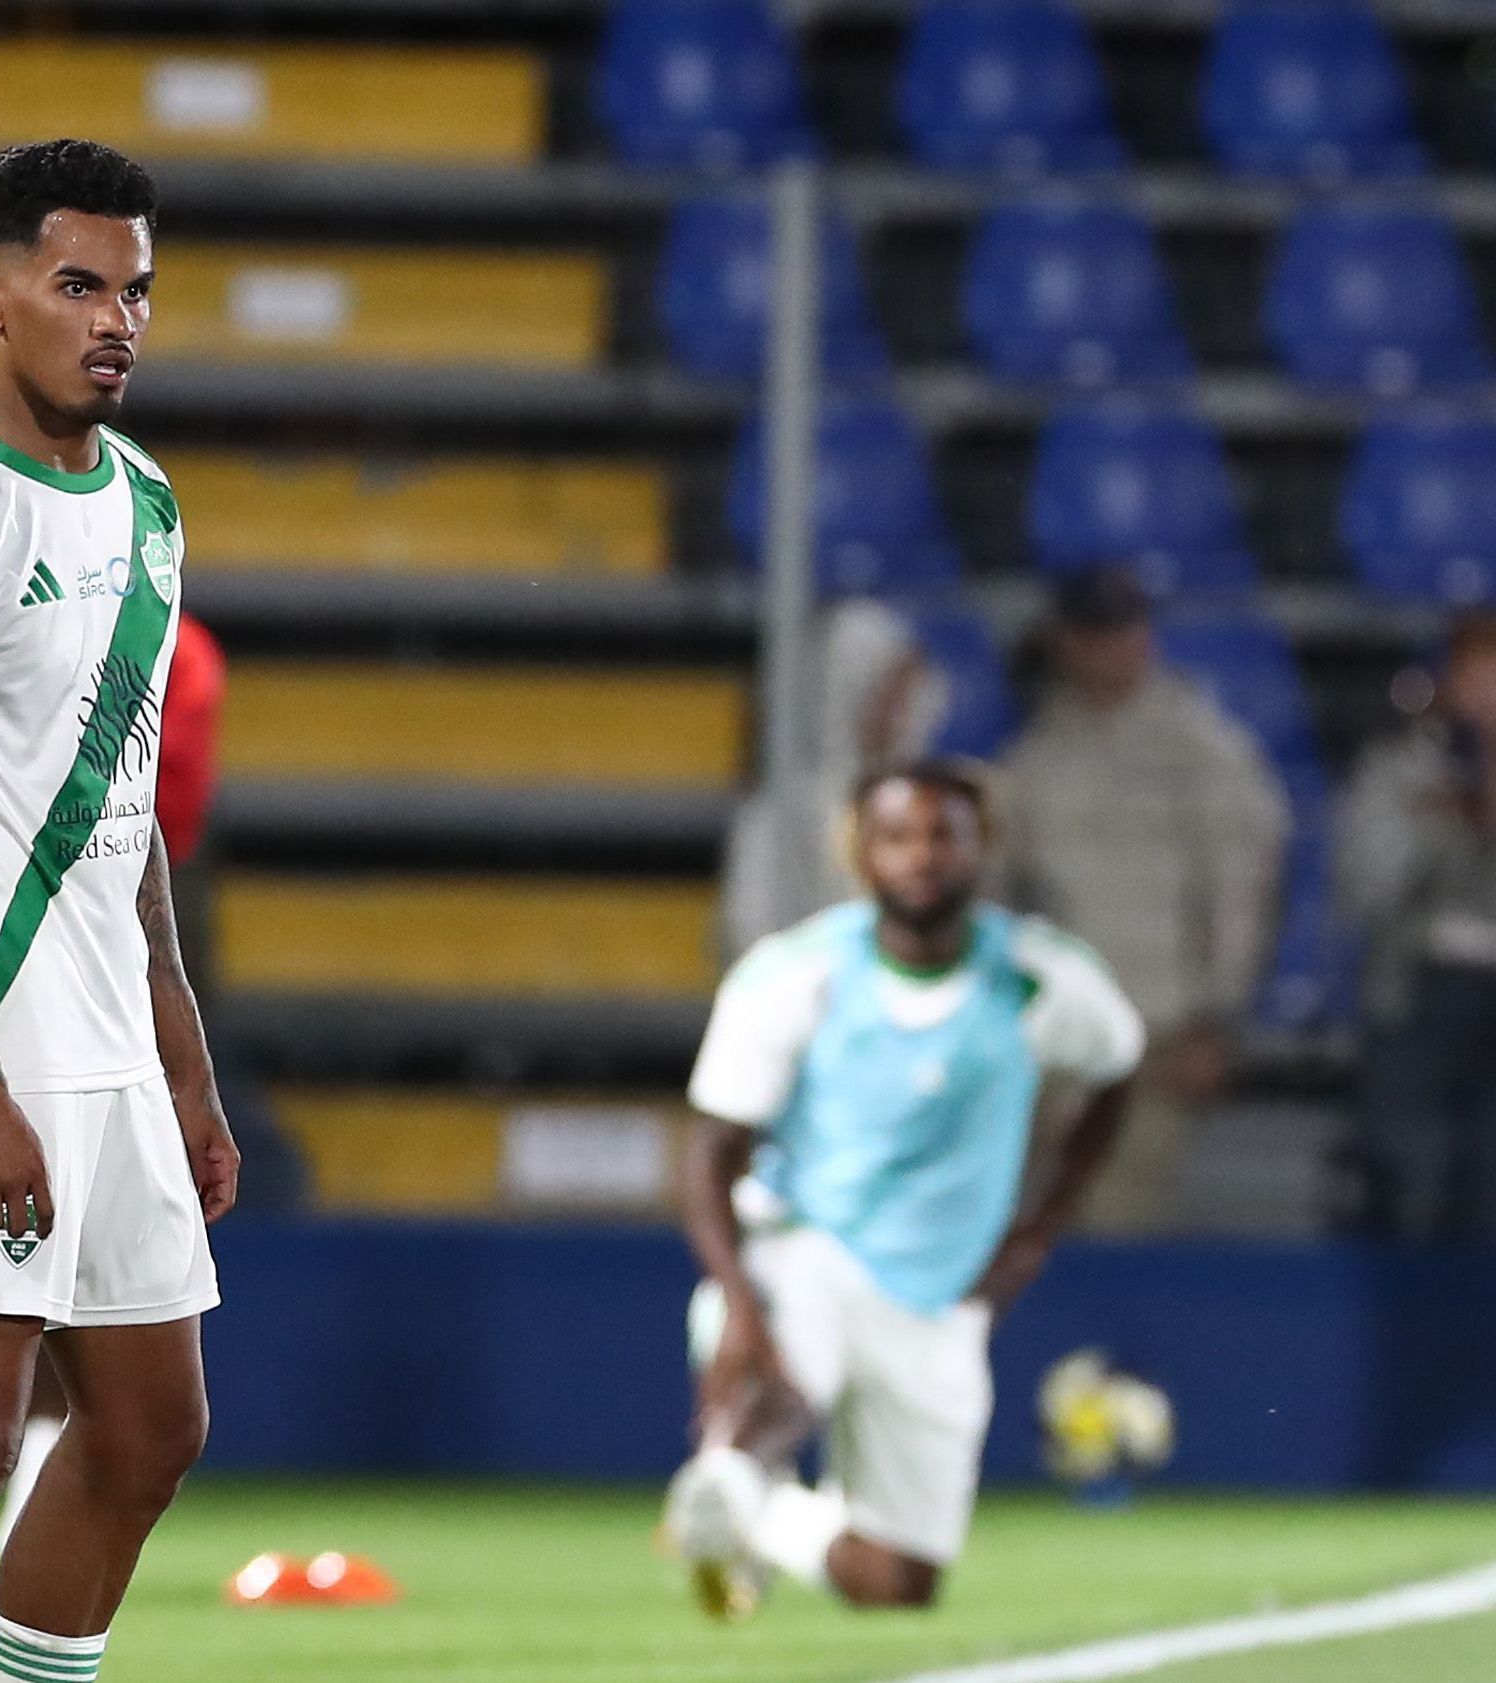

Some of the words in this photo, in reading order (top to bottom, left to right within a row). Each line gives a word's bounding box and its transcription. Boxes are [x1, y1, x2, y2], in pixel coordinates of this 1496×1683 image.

[79, 584, 106, 599] SIRC
[57, 834, 98, 860] Red
[103, 834, 129, 857] Sea
